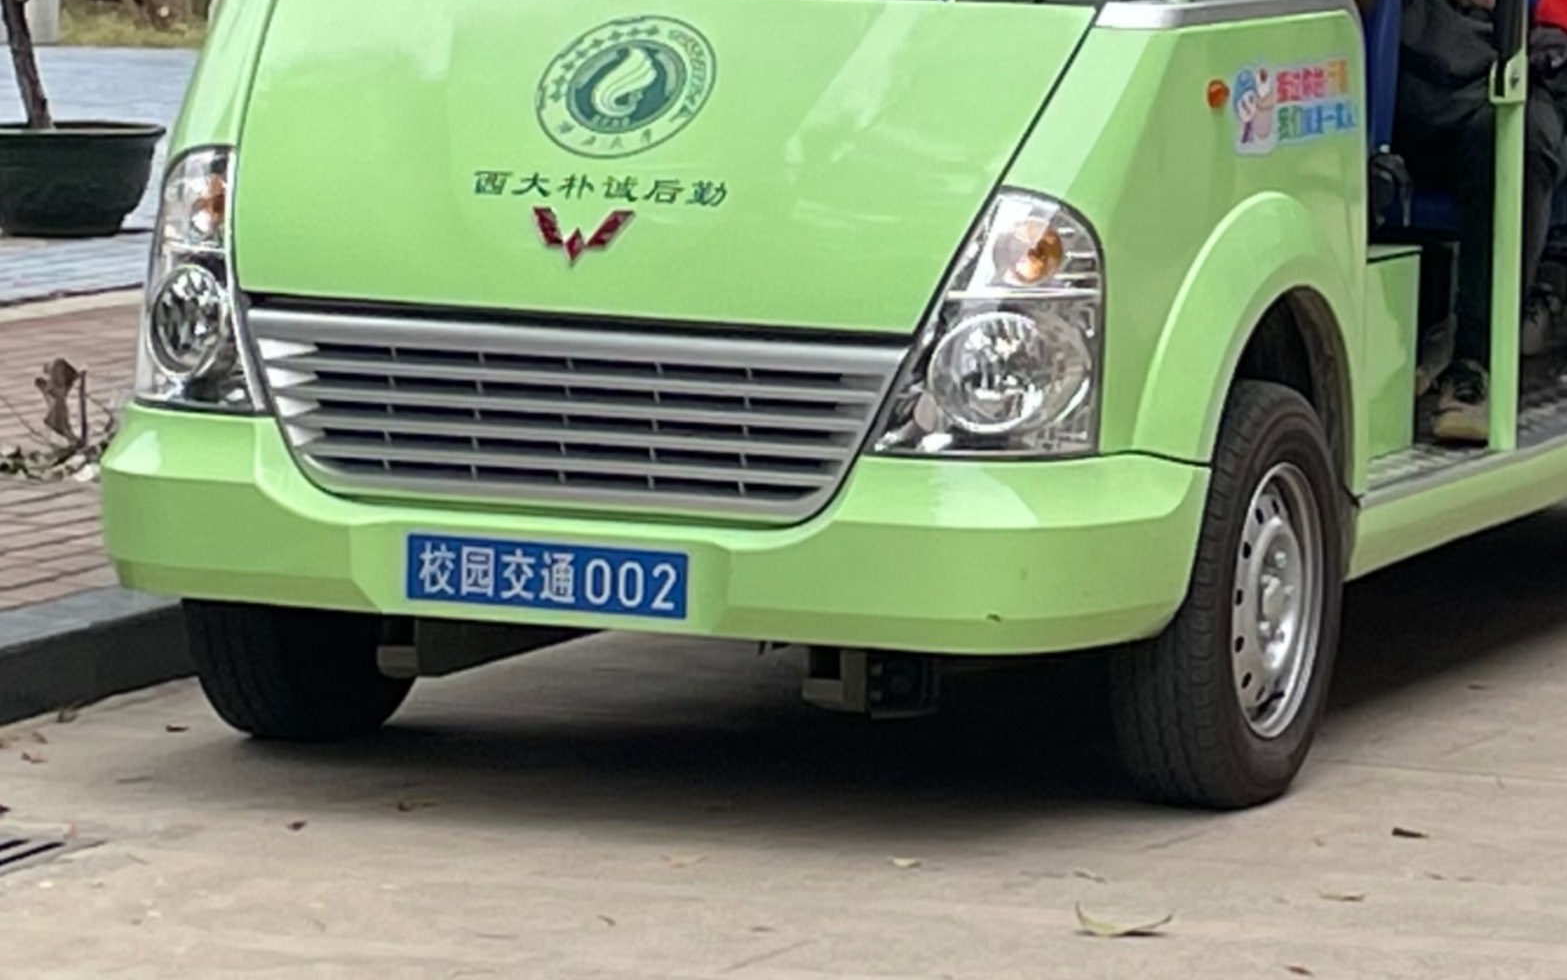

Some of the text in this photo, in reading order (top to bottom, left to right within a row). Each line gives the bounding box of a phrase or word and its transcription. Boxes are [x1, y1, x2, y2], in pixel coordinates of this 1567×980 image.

[473, 170, 728, 207] 西大朴诚后勤
[418, 540, 677, 611] 校园交通002
